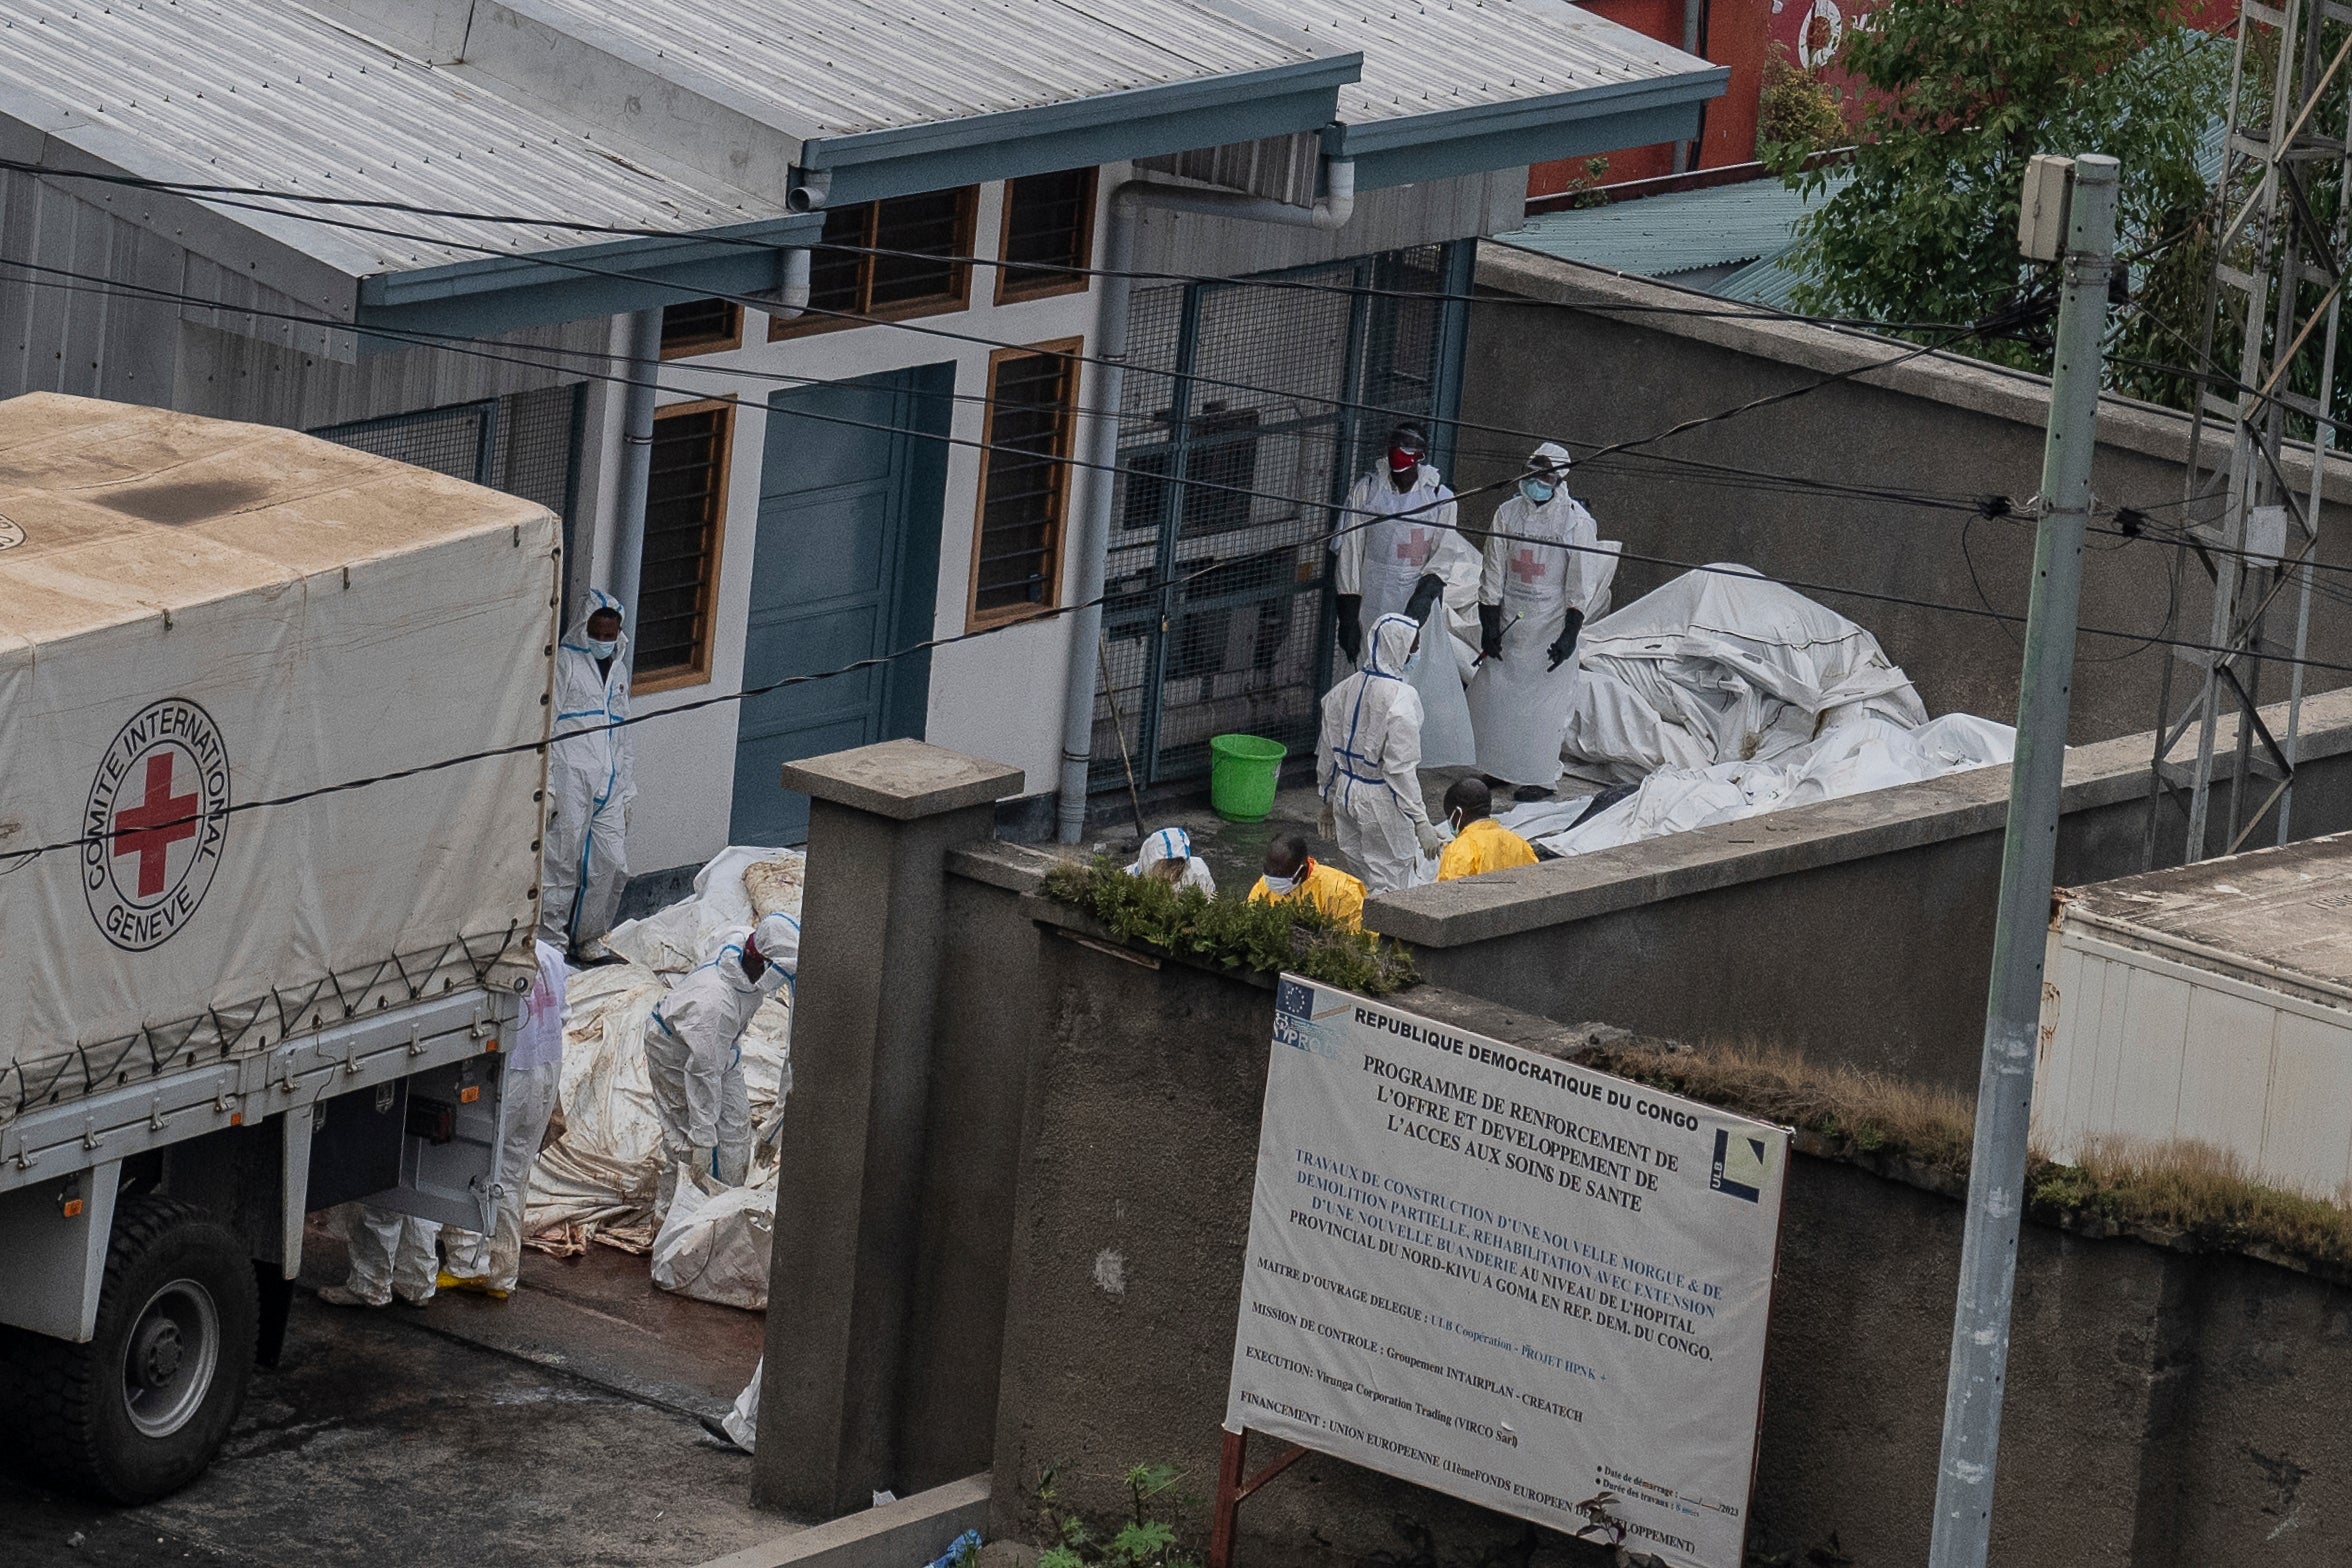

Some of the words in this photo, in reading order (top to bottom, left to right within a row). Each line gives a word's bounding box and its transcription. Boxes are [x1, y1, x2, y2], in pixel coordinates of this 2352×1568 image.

[86, 751, 124, 891] COMITE
[124, 707, 225, 864] INTERNATIONAL
[106, 884, 195, 943] GENEVE
[1353, 1006, 1464, 1056] REPUBLIQUE
[1467, 1042, 1603, 1102] DEMOCRATIQUE
[1606, 1088, 1632, 1111] DU
[1635, 1099, 1699, 1132] CONGO
[1362, 1053, 1478, 1106] PROGRAMME
[1480, 1091, 1506, 1116] DE
[1508, 1100, 1652, 1163] RENFORCEMENT
[1653, 1148, 1679, 1173] DE
[1376, 1083, 1450, 1123] L'OFFRE
[1453, 1109, 1478, 1131] ET
[1479, 1117, 1632, 1183] DEVELOPPEMENT
[1633, 1168, 1659, 1193] DE
[1386, 1113, 1461, 1152] L'ACCES
[1463, 1139, 1502, 1166] AUX
[1504, 1151, 1555, 1183] SOINS
[1557, 1169, 1582, 1193] DE
[1584, 1179, 1642, 1213] SANTE
[1711, 1161, 1723, 1189] ULB
[1288, 1208, 1376, 1250] PROVINCIAL
[1377, 1238, 1399, 1257] DU
[1400, 1245, 1481, 1284] NORD-KIVU
[1481, 1273, 1493, 1289] A
[1494, 1277, 1538, 1305] GOMA
[1540, 1292, 1561, 1312] EN
[1562, 1299, 1593, 1323] REP.
[1595, 1310, 1631, 1336] DEM.
[1633, 1323, 1655, 1342] DU
[1656, 1331, 1713, 1362] CONGO.
[1296, 1148, 1359, 1181] TRAVAUX
[1360, 1169, 1380, 1188] DE
[1382, 1177, 1493, 1225] CONSTRUCTION
[1541, 1229, 1618, 1268] NOUVELLE
[1621, 1255, 1685, 1289] MORGUE
[1686, 1278, 1699, 1293] &
[1702, 1282, 1723, 1301] DE
[1296, 1169, 1387, 1211] DEMOLITION
[1472, 1227, 1591, 1279] REHABILITATION
[1593, 1269, 1632, 1292] AVEC
[1633, 1281, 1716, 1319] EXTENSION
[1357, 1210, 1434, 1248] NOUVELLE
[1435, 1236, 1518, 1276] BUANDERIE
[1518, 1264, 1540, 1283] AU
[1540, 1271, 1596, 1302] NIVEAU
[1598, 1290, 1618, 1310] DE
[1250, 1300, 1298, 1327] MISSION
[1298, 1316, 1316, 1332] DE
[1316, 1322, 1378, 1353] CONTROLE
[1385, 1346, 1444, 1376] Groupement
[1445, 1365, 1515, 1399] INTAIRPLAN
[1520, 1392, 1583, 1423] CREATECH
[1255, 1255, 1301, 1281] MAITRE
[1368, 1293, 1423, 1322] DELEGUE
[1430, 1313, 1453, 1332] ULB
[1520, 1343, 1563, 1369] PROJET
[1563, 1359, 1596, 1381] HPNK
[1239, 1389, 1321, 1426] FINANCEMENT
[1328, 1419, 1365, 1441] UNION
[1365, 1432, 1441, 1468] EUROPEENNE
[1512, 1482, 1573, 1513] EUROPEEN
[1244, 1344, 1314, 1378] EXECUTION:
[1315, 1367, 1354, 1392] Virunga
[1354, 1382, 1413, 1412] Corporation
[1414, 1401, 1453, 1427] Trading
[1453, 1415, 1494, 1439] (VIRCO
